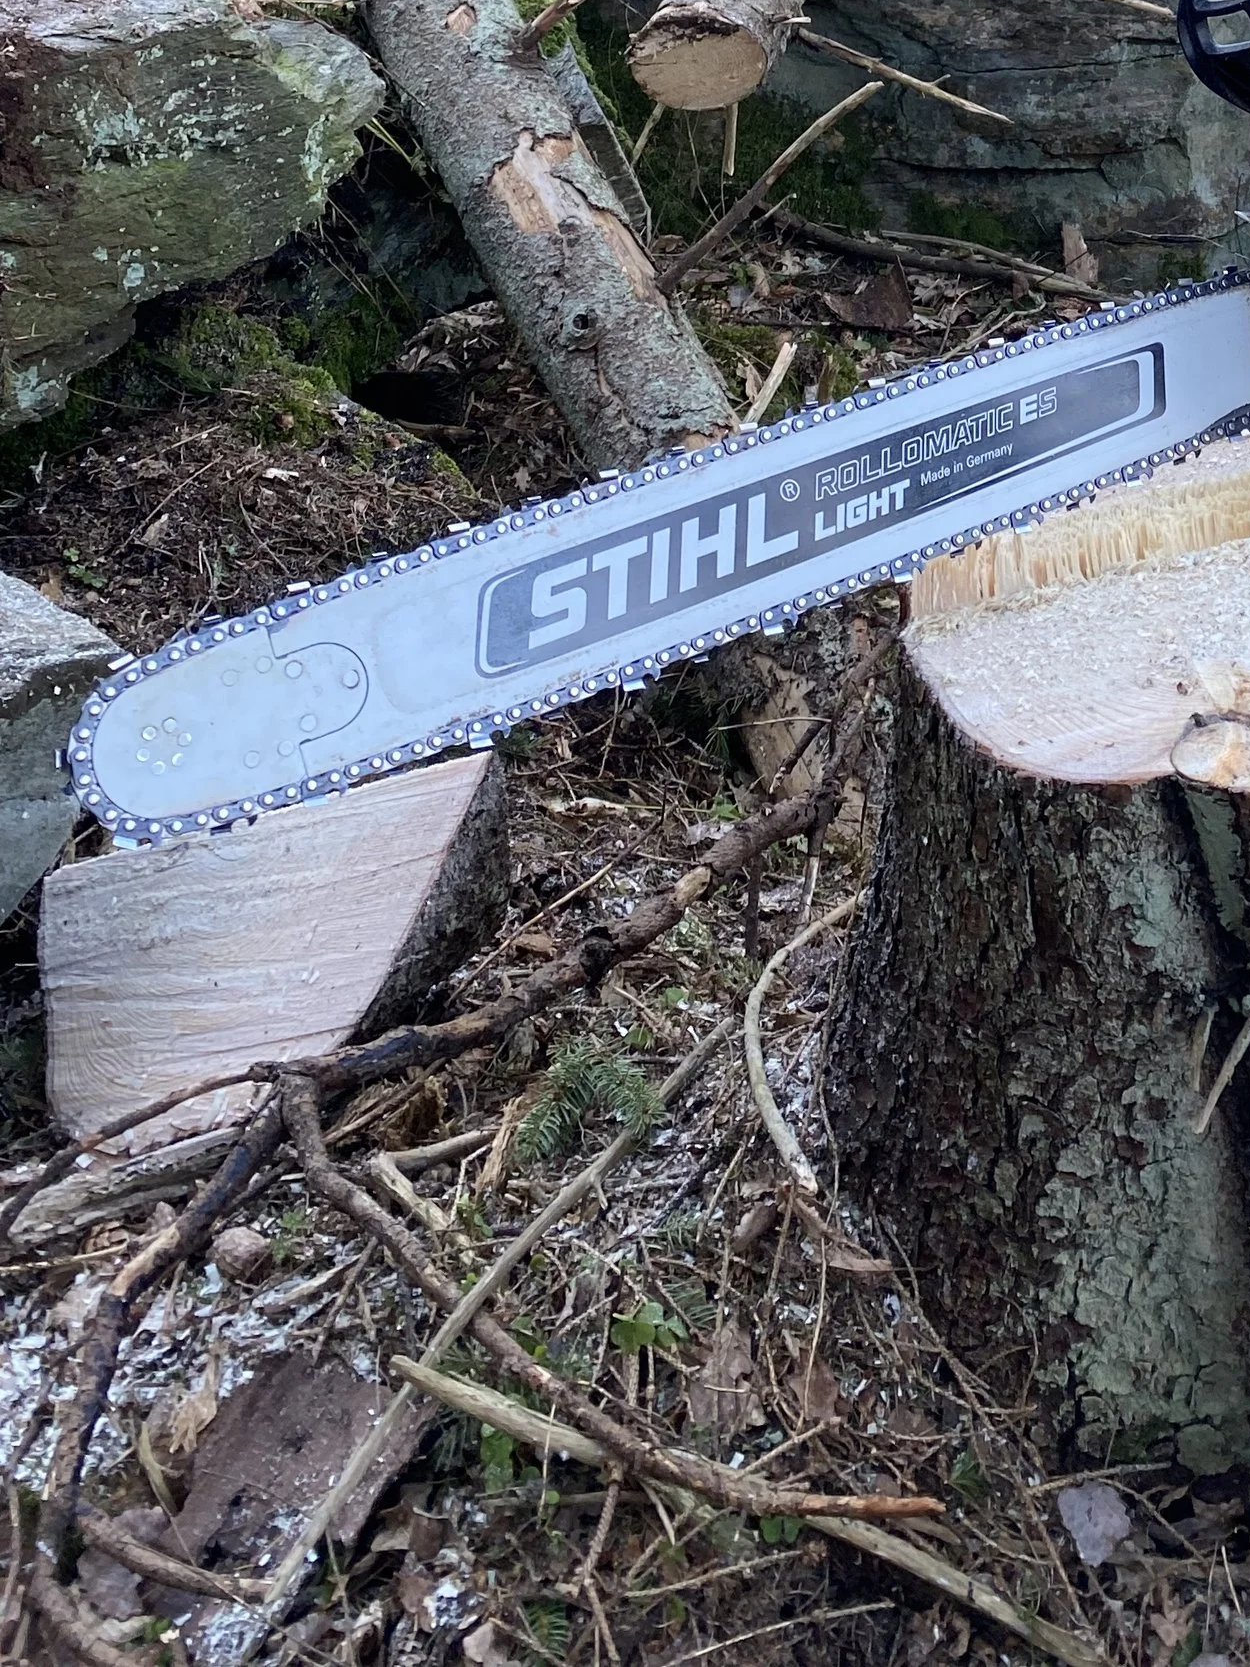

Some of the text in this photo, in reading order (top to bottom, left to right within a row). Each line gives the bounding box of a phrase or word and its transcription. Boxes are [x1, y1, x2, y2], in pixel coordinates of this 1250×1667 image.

[815, 386, 1057, 502] ROLLOMATIC ES
[920, 443, 1013, 487] Made in Germany
[814, 479, 910, 542] LIGHT
